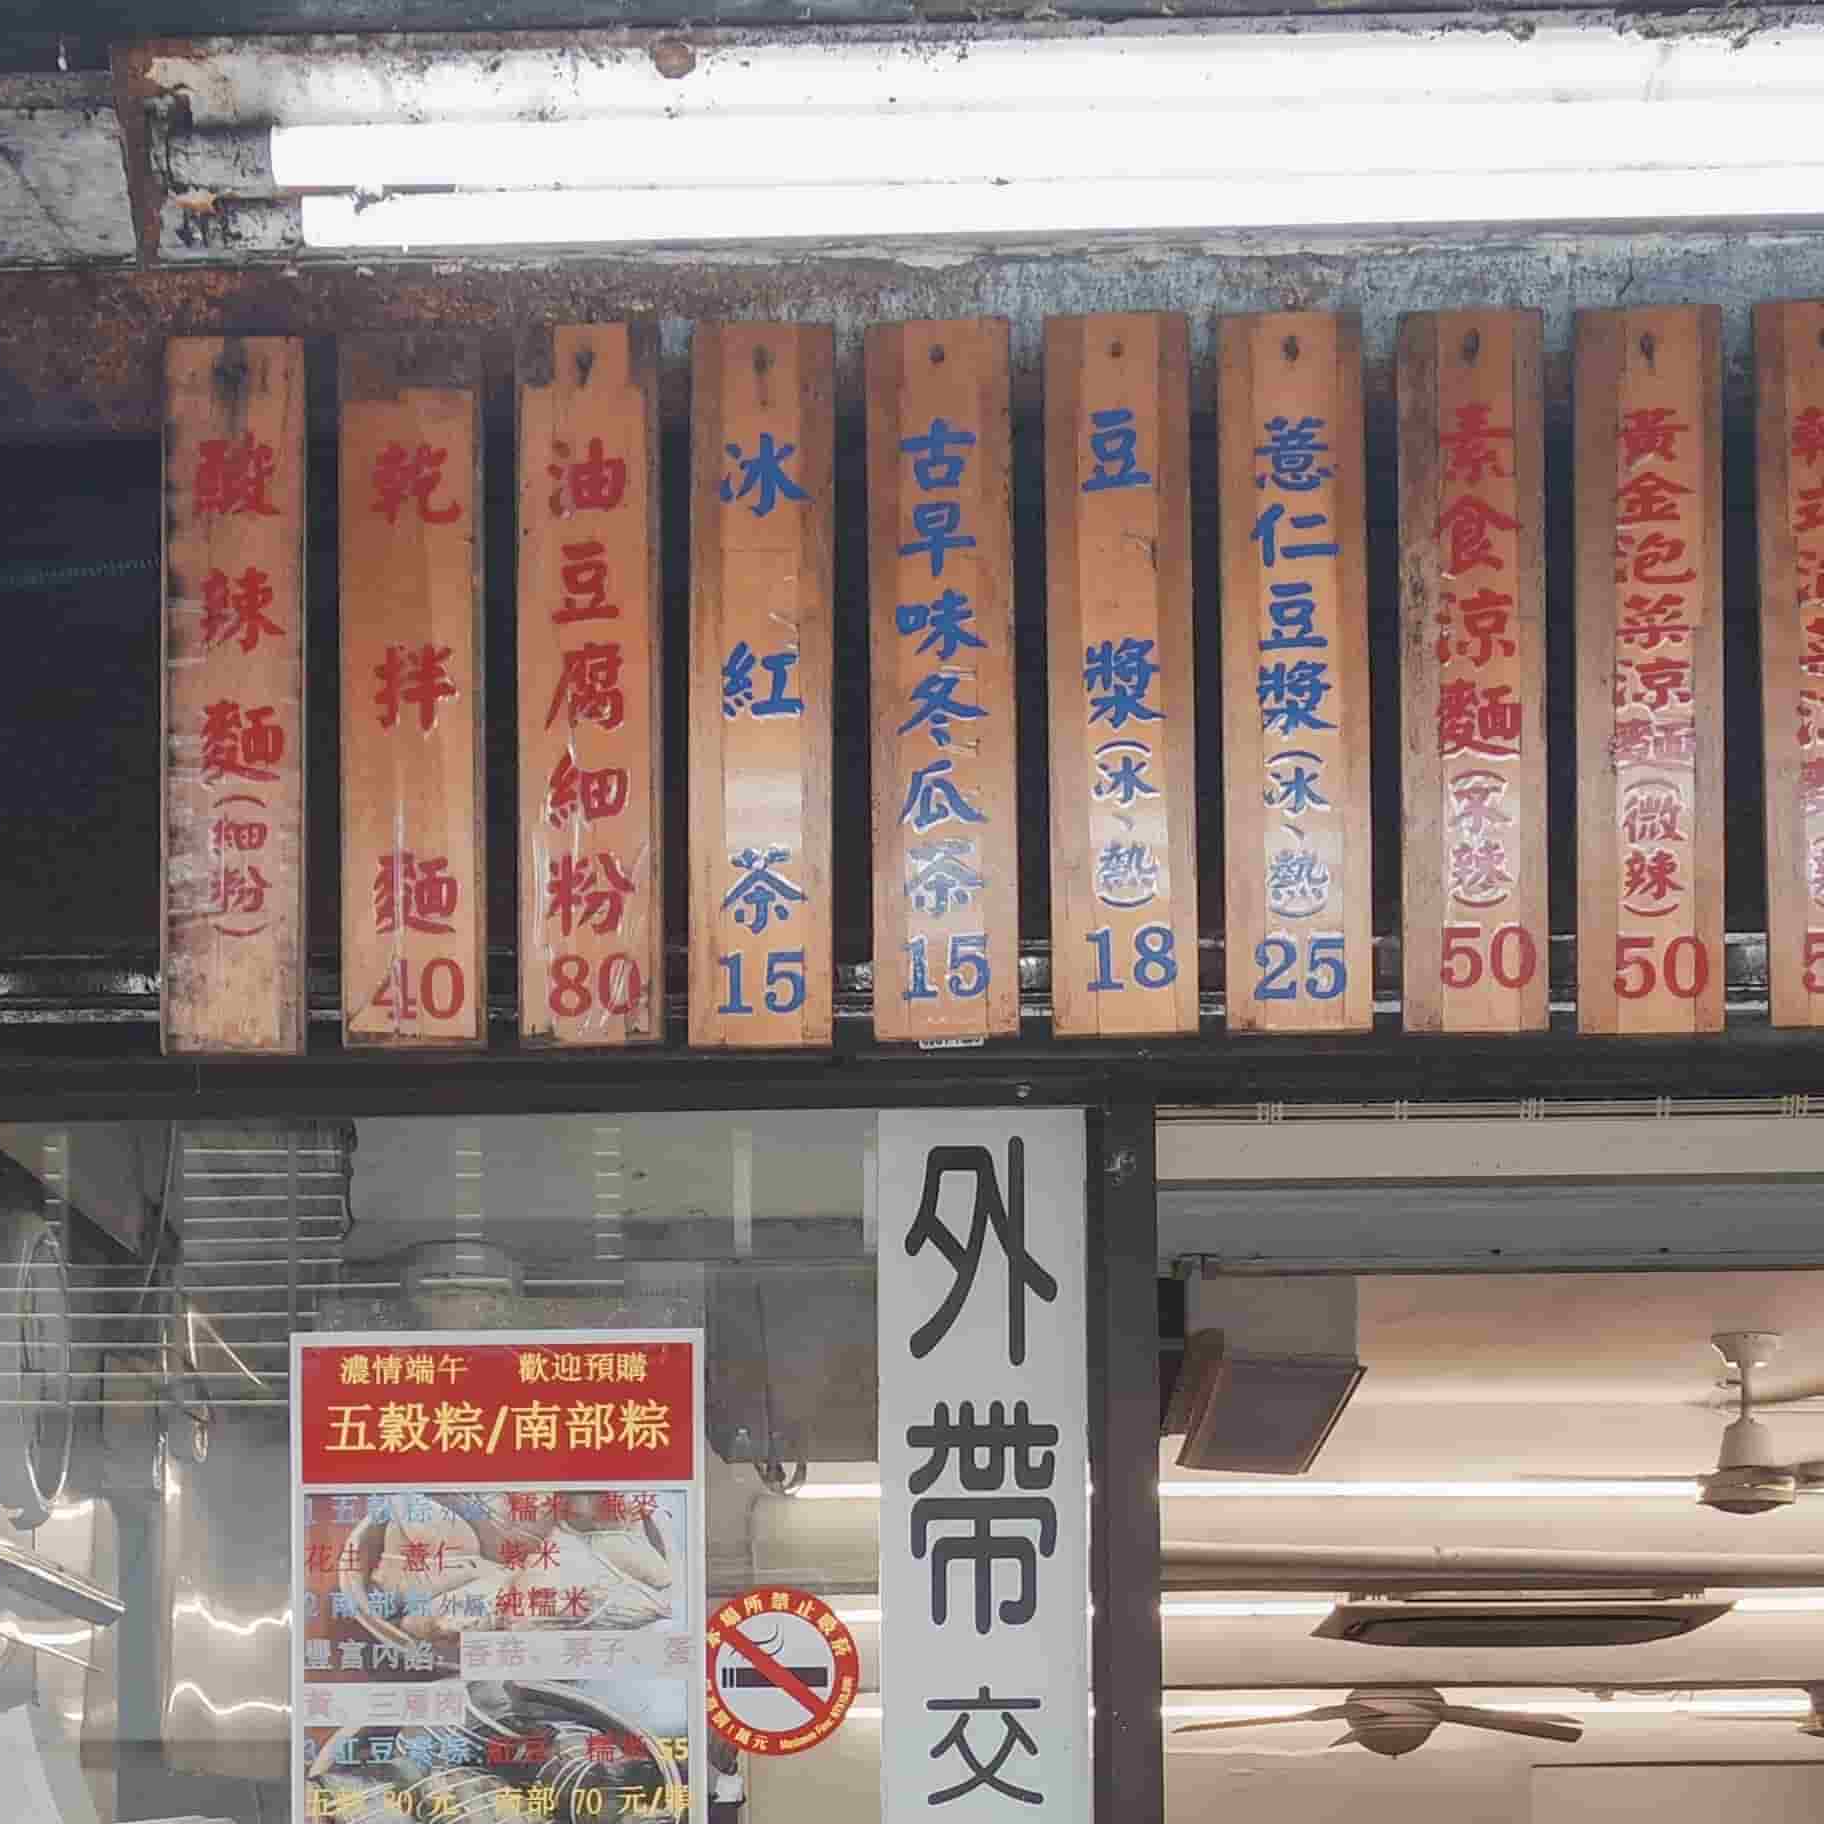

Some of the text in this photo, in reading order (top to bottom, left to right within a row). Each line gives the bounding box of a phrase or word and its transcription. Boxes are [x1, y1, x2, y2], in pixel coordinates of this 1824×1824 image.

[896, 418, 991, 919] 古早味冬瓜茶
[369, 441, 465, 1020] 乾拌麵 40
[544, 437, 642, 1017] 油豆腐細粉 80
[717, 432, 814, 1015] 冰紅茶 15
[902, 933, 992, 1001] 15
[1086, 926, 1177, 992] 18
[1253, 936, 1348, 1002] 25
[1440, 926, 1537, 989] 50
[1613, 936, 1709, 1000] 50
[339, 1352, 648, 1386] 濃情端午 歡迎預購
